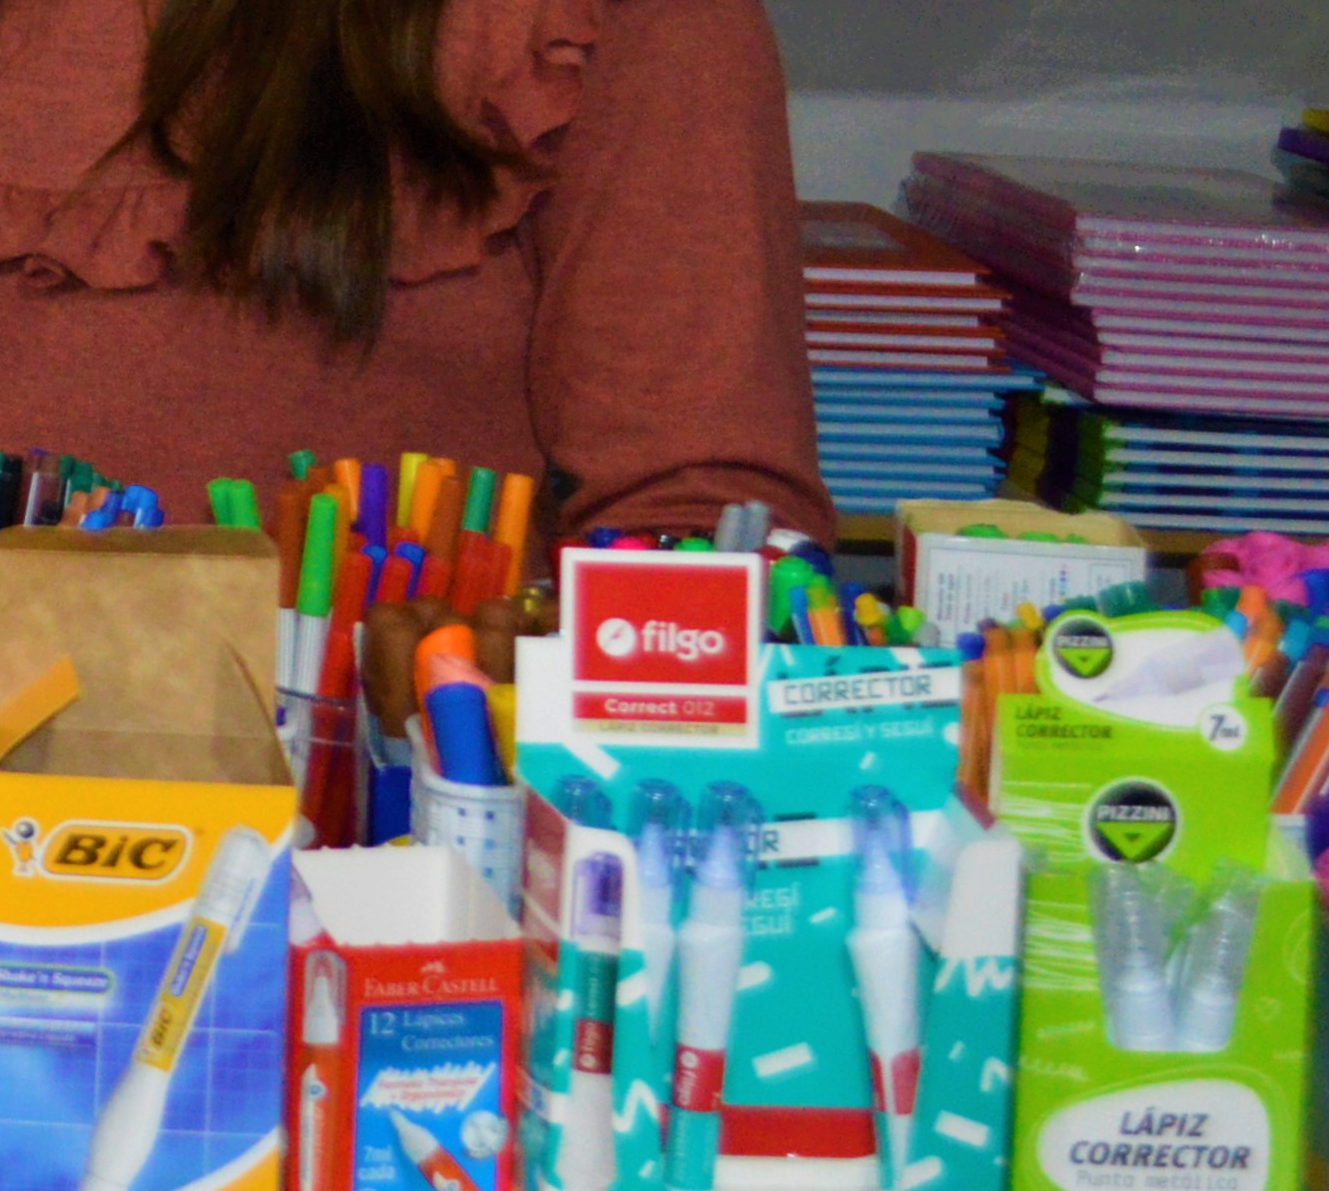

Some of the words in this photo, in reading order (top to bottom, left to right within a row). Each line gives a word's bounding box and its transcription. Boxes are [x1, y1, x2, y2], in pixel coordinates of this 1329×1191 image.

[642, 621, 724, 660] filgo
[785, 673, 931, 704] CORRECTOR
[604, 698, 677, 715] Correct
[1015, 704, 1061, 721] LÁPIZ
[785, 724, 862, 744] CORREGÍ
[880, 718, 934, 738] SEGUÍ
[1015, 724, 1113, 740] CORRECTOR
[1098, 806, 1170, 822] PIZZINI
[364, 975, 498, 997] FABER-CASTELL
[369, 1012, 395, 1036] 12
[402, 1011, 465, 1029] Lápices
[402, 1035, 495, 1053] Correctores
[582, 1022, 598, 1053] filgo
[679, 1068, 693, 1107] filgo
[1119, 1107, 1208, 1138] LÁPIZ
[1069, 1141, 1251, 1169] CORRECTOR
